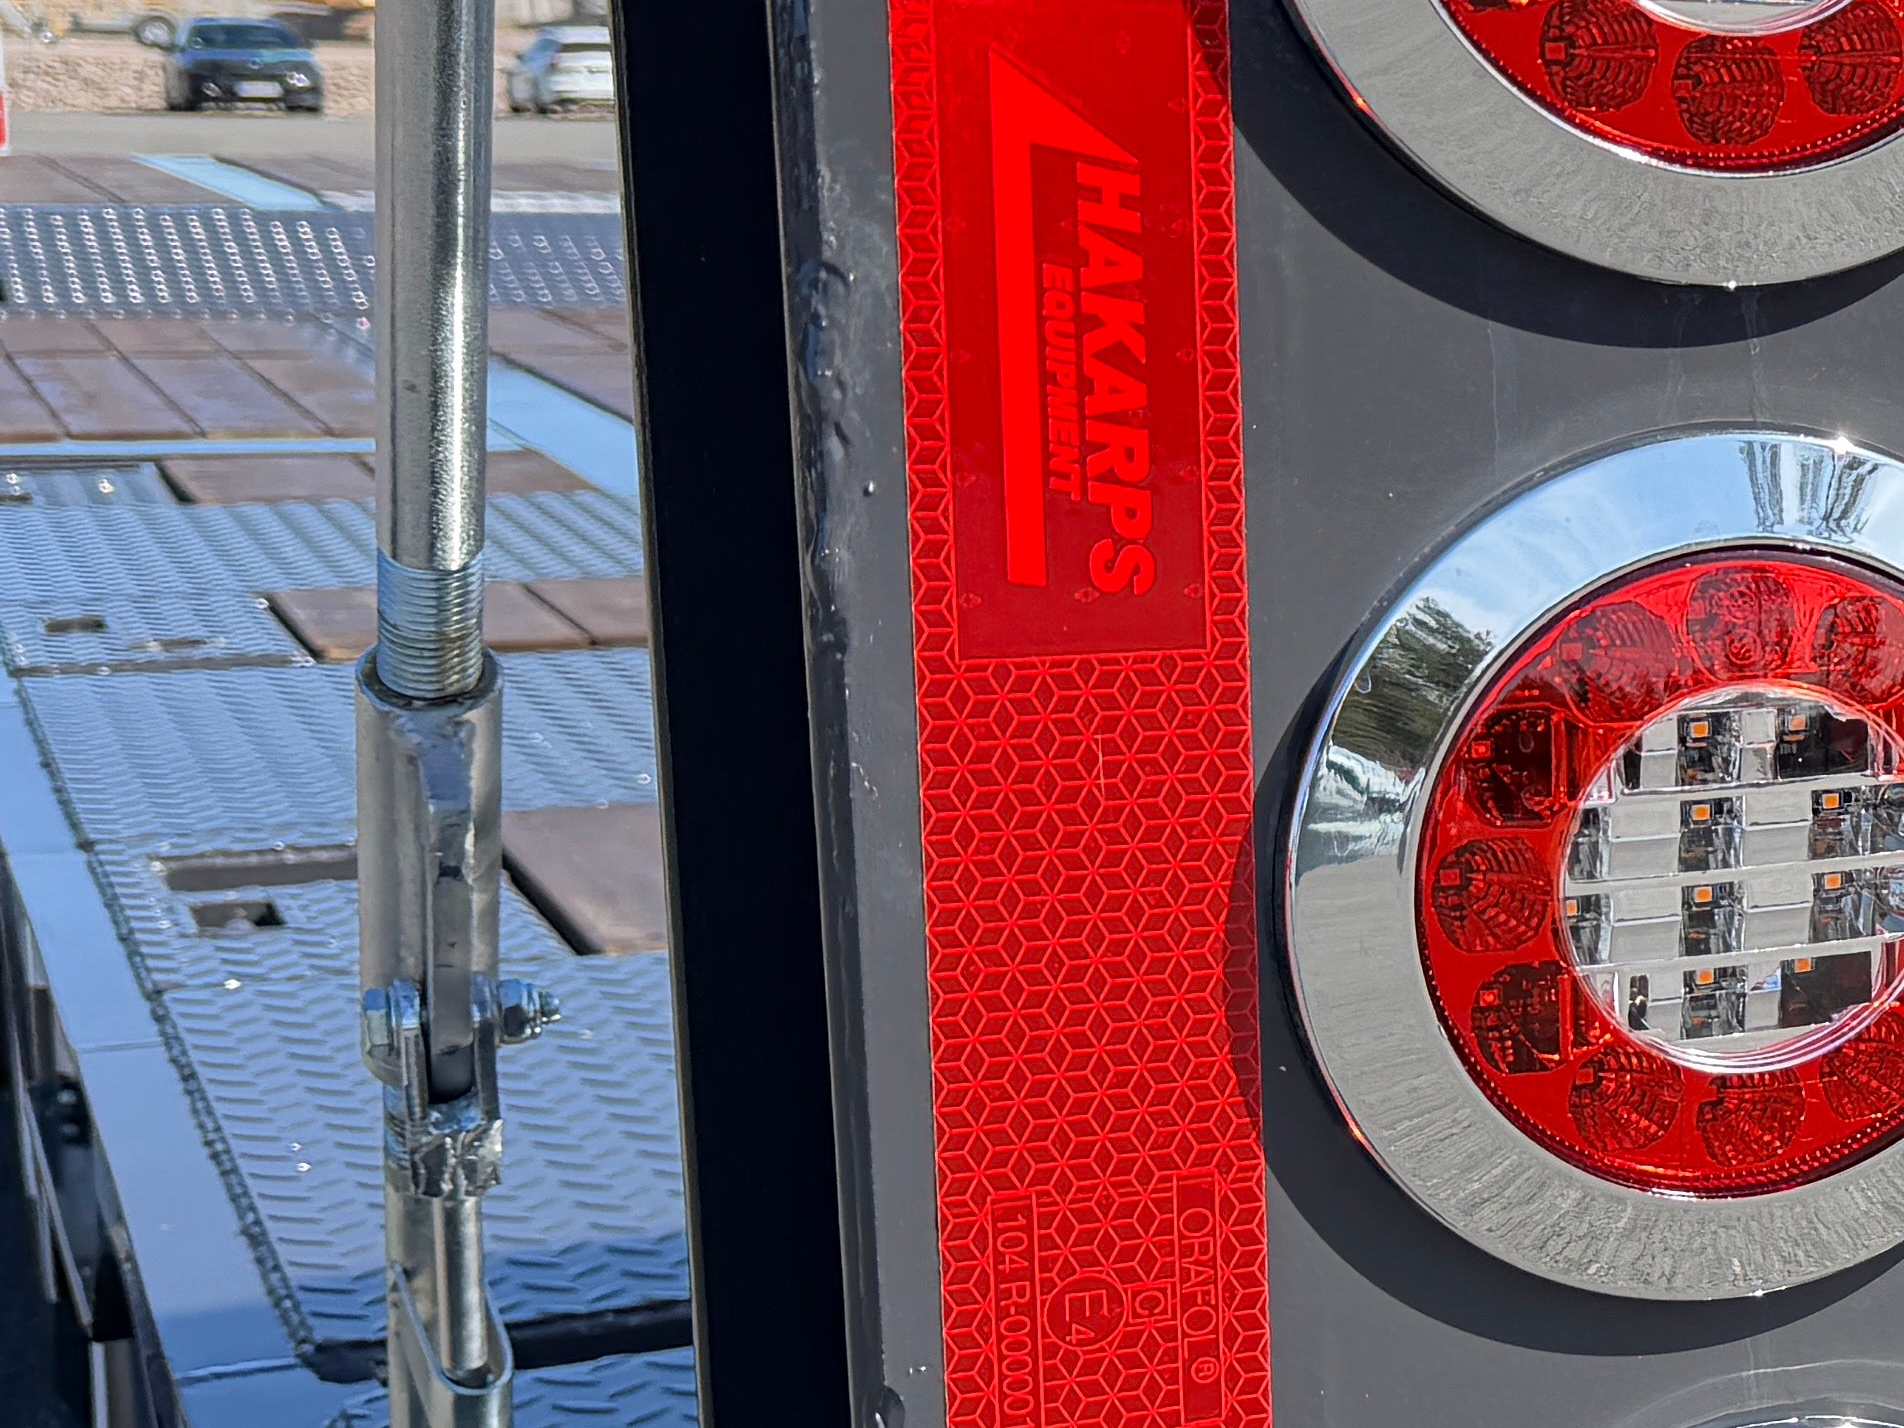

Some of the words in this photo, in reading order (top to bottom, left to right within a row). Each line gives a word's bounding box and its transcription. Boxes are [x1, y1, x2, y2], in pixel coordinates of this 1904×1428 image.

[1041, 262, 1082, 502] EQUIPMENT
[1075, 160, 1157, 597] HAKARPS
[996, 1213, 1029, 1274] 104
[1178, 1207, 1217, 1360] ORAFOL
